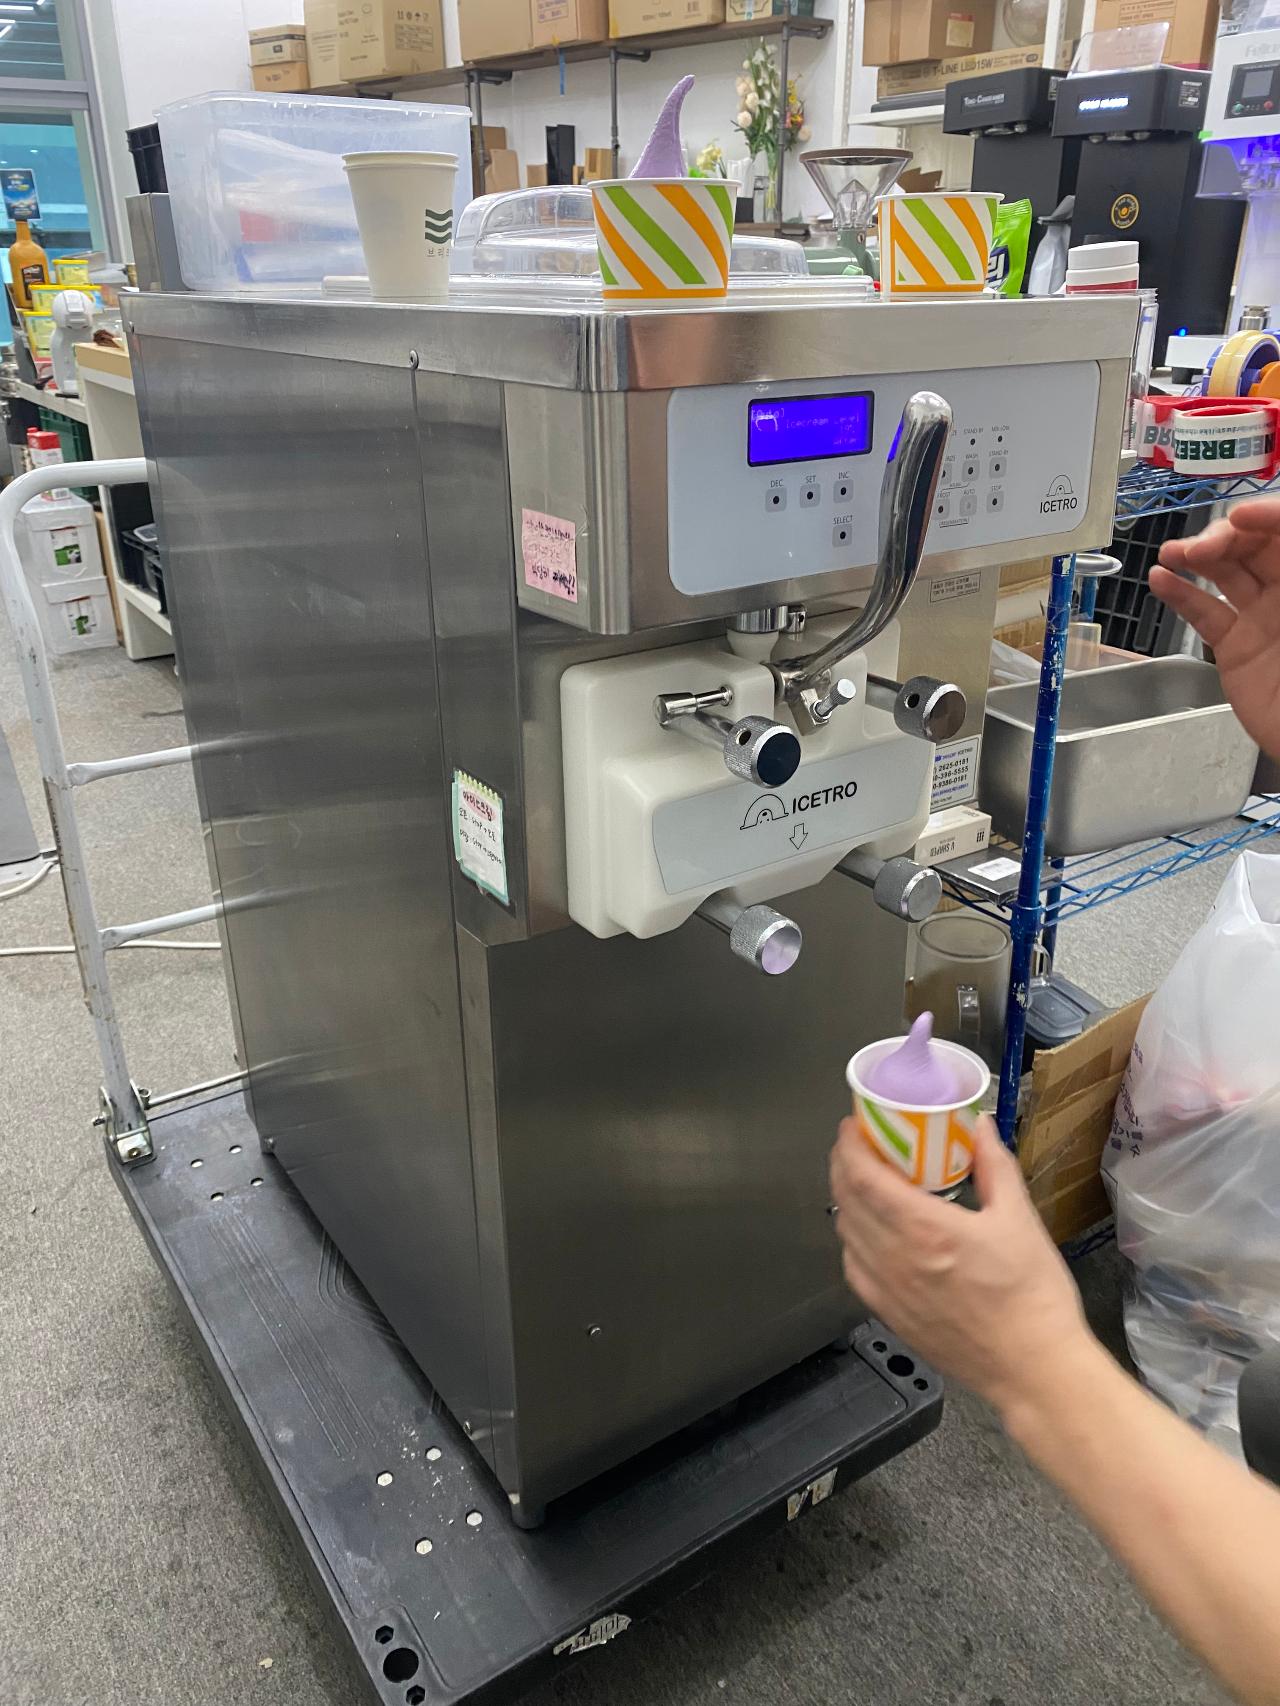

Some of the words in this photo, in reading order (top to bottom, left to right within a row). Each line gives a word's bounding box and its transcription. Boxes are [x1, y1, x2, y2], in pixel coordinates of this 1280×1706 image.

[805, 475, 816, 483] SET
[1040, 498, 1077, 514] ICETRO
[832, 515, 853, 525] SELECT
[793, 782, 858, 814] ICETRO
